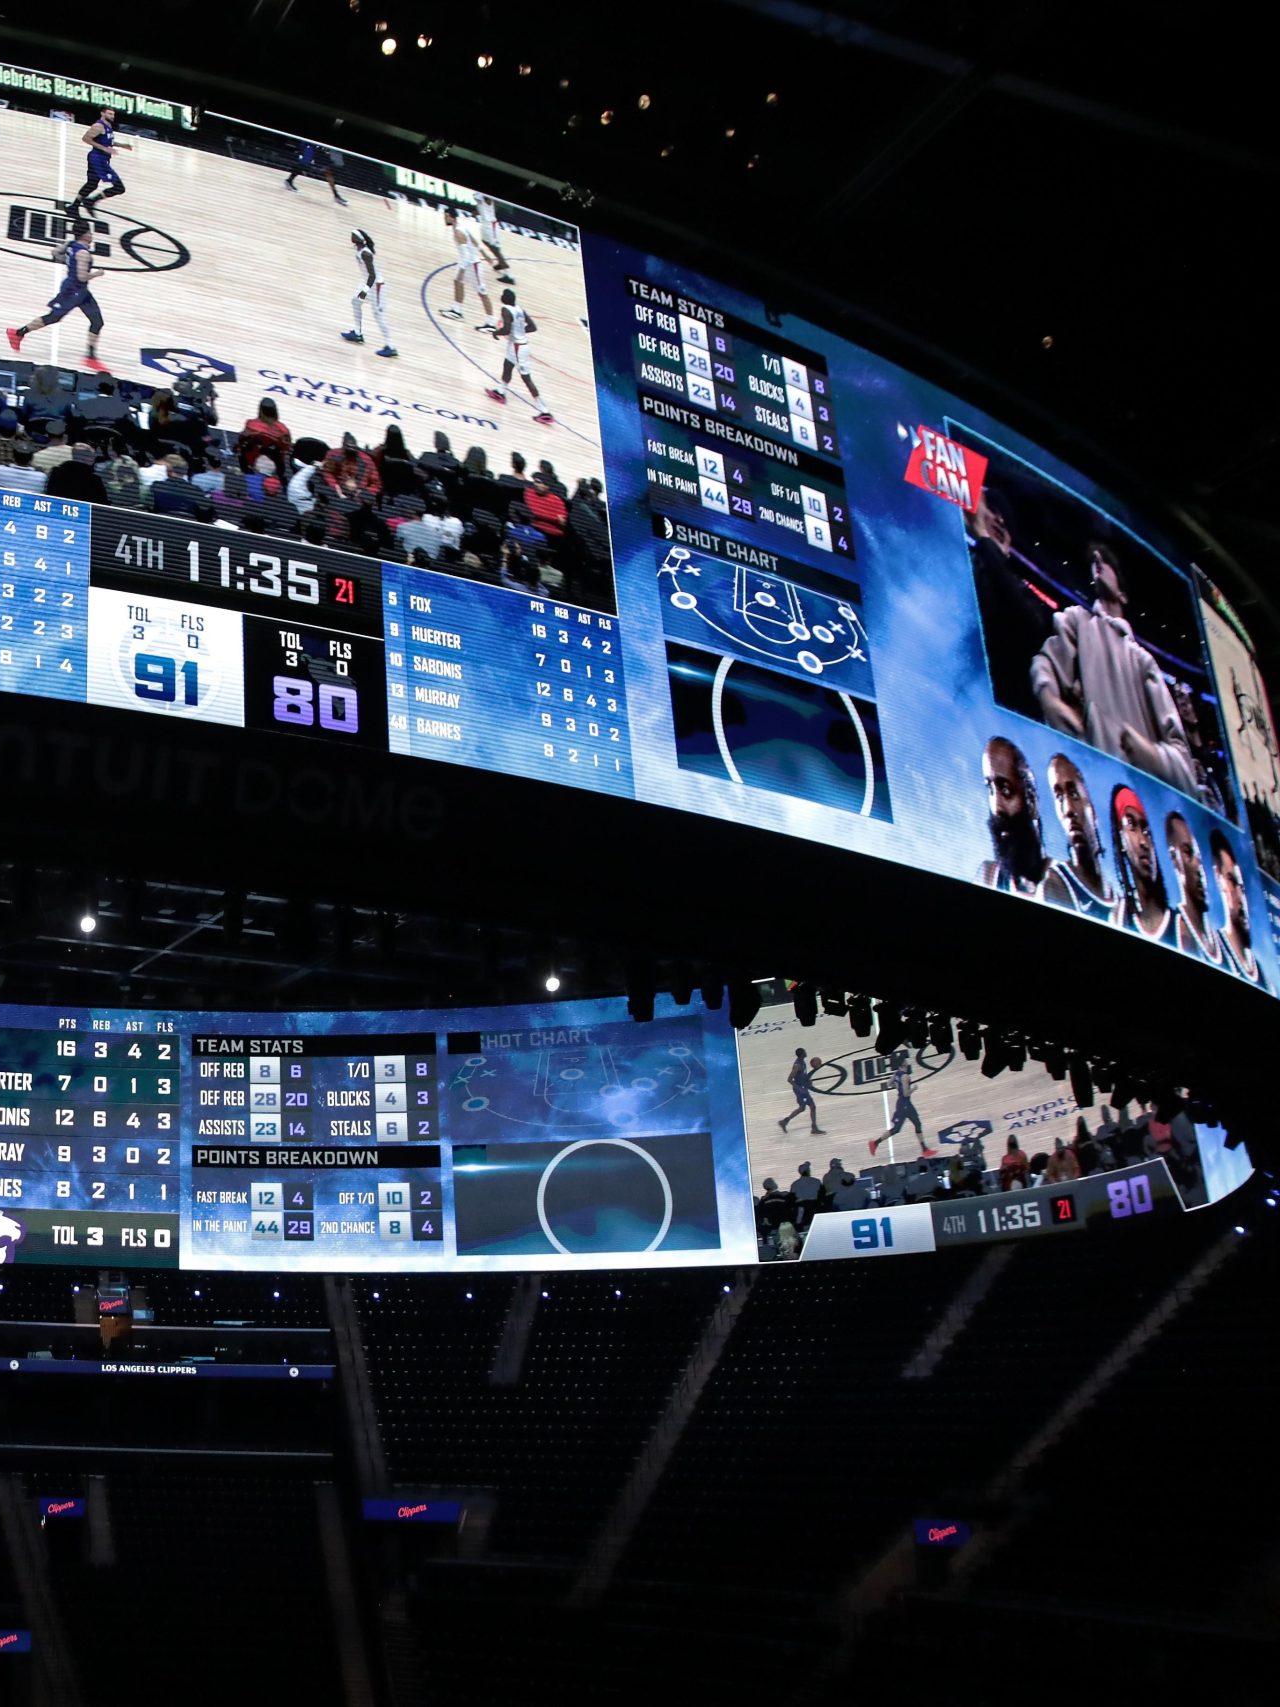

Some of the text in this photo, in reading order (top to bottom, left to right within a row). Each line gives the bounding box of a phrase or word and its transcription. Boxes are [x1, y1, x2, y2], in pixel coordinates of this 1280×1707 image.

[54, 78, 90, 100] Black
[91, 86, 134, 113] History
[136, 96, 173, 120] Month
[629, 280, 724, 328] TEAM STATS
[635, 304, 676, 333] OFF REB
[638, 332, 680, 362] DEF REB
[641, 363, 684, 392] ASSISTS
[748, 375, 784, 403] BLOCKS
[258, 369, 499, 430] crypto.com
[265, 385, 402, 420] ARENA
[643, 396, 798, 466] POINTS BREAKDOWN
[755, 406, 789, 432] STEALS
[922, 430, 967, 477] FAN
[921, 460, 972, 509] CAM
[3, 495, 21, 508] REB
[34, 500, 51, 513] AST
[63, 505, 79, 517] FLS
[676, 525, 778, 572] SHOT CHART
[114, 534, 354, 605] 4TH 11:35 21
[410, 595, 432, 614] FOX
[530, 601, 611, 630] PTS REB AST FLS
[127, 605, 204, 632] TOL FLS
[132, 625, 144, 640] 3
[279, 631, 352, 659] TOL FLS
[412, 626, 461, 649] HUERTER
[286, 651, 298, 666] 3
[390, 653, 462, 679] 10 SABONIS
[134, 653, 198, 707] 91
[273, 675, 358, 733] 80
[391, 683, 460, 709] 13 MURRAY
[390, 714, 461, 741] 40 BARNES
[59, 1019, 173, 1032] PTS REB AST FLS
[197, 1040, 304, 1053] TEAM STATS
[200, 1063, 244, 1078] OFF REB
[348, 1063, 369, 1078] T/O
[200, 1091, 244, 1106] DEF REB
[327, 1091, 370, 1106] BLOCKS
[199, 1120, 245, 1135] ASSISTS
[330, 1120, 371, 1136] STEALS
[197, 1151, 378, 1165] POINTS BREAKDOWN
[197, 1192, 247, 1203] FAST BREAK
[339, 1192, 374, 1204] OFF T/O
[852, 1175, 1154, 1250] 91 4TH 11:35 21 80
[52, 1226, 78, 1245] TOL
[87, 1227, 103, 1245] 3
[121, 1228, 146, 1247] FLS
[193, 1221, 247, 1233] IN THE PAINT
[321, 1222, 375, 1234] 2ND CHANCE
[47, 1501, 75, 1514] Clippers
[397, 1504, 428, 1518] Clippers
[928, 1525, 957, 1542] Clippers
